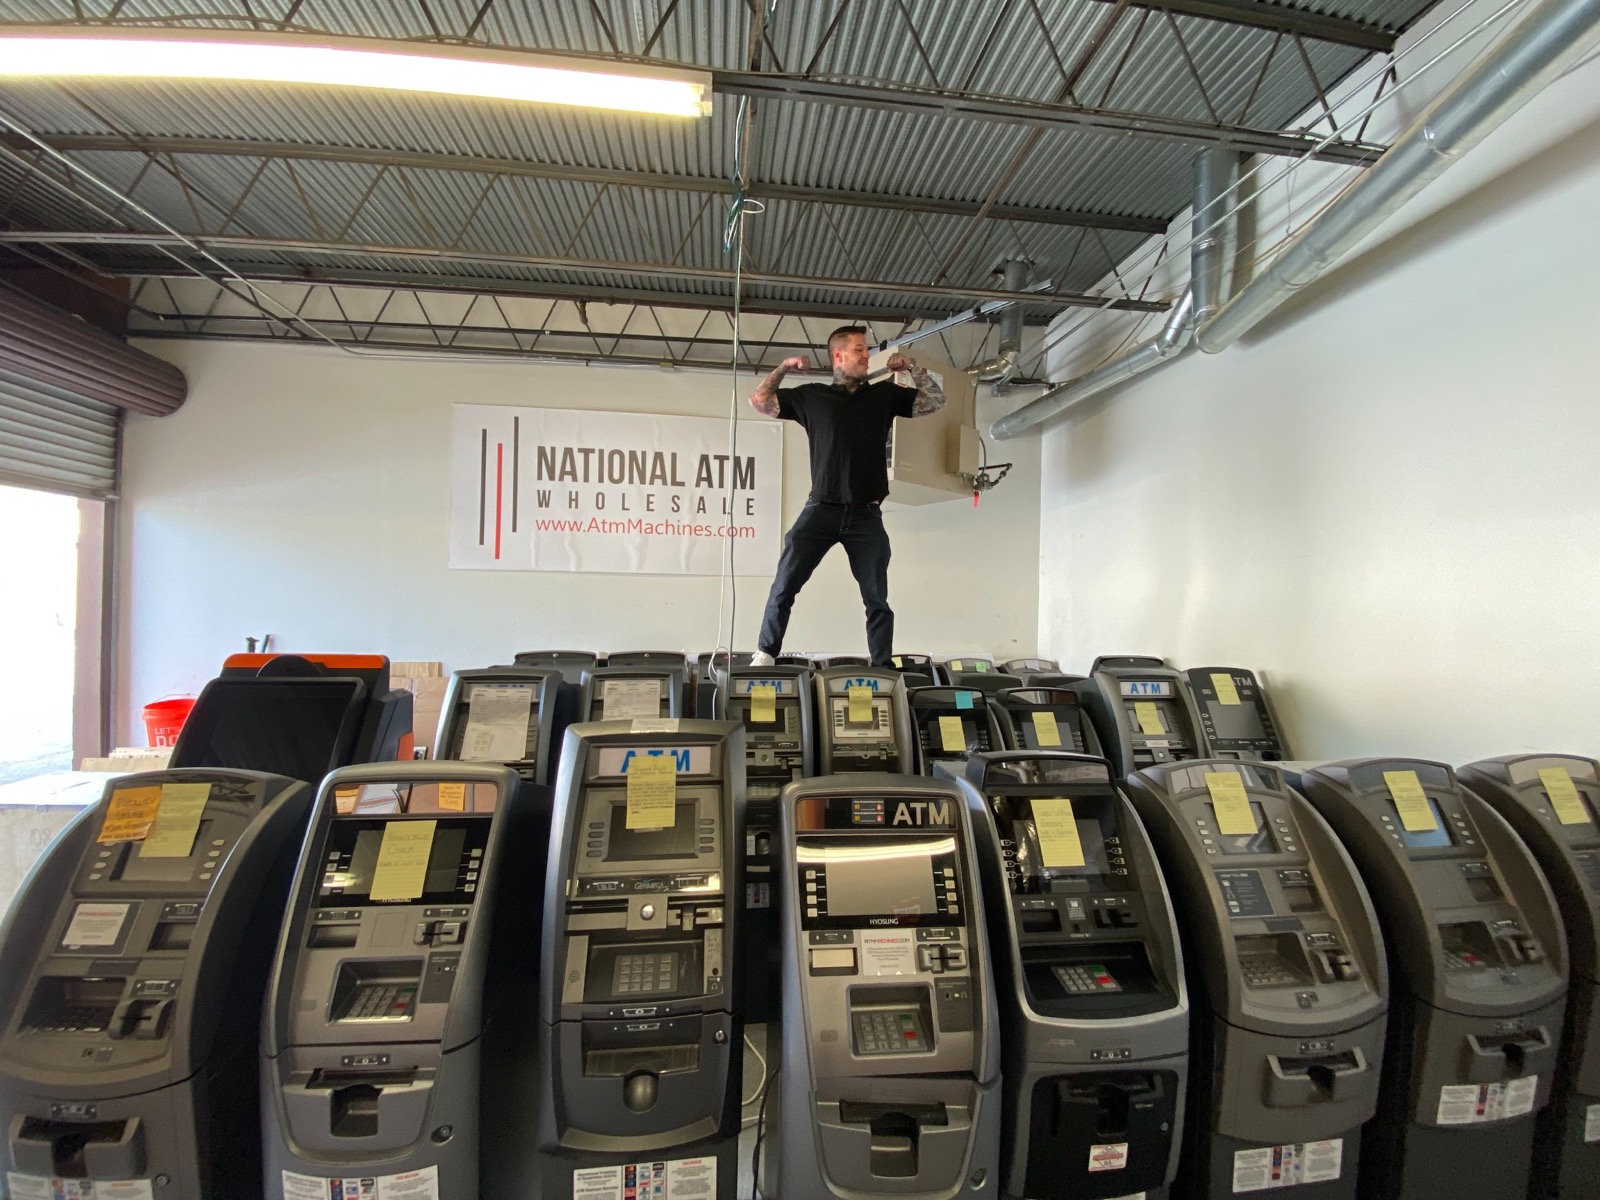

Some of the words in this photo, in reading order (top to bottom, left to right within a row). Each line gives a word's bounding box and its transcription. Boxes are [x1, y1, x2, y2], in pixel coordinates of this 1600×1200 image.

[537, 445, 685, 487] NATIONAL
[695, 453, 755, 490] ATM
[537, 489, 754, 516] WHOLESALE
[535, 516, 755, 538] www.AtmMachines.com
[1130, 683, 1161, 694] ATM
[1232, 677, 1253, 686] TM
[620, 749, 690, 773] AM
[892, 802, 950, 826] ATM
